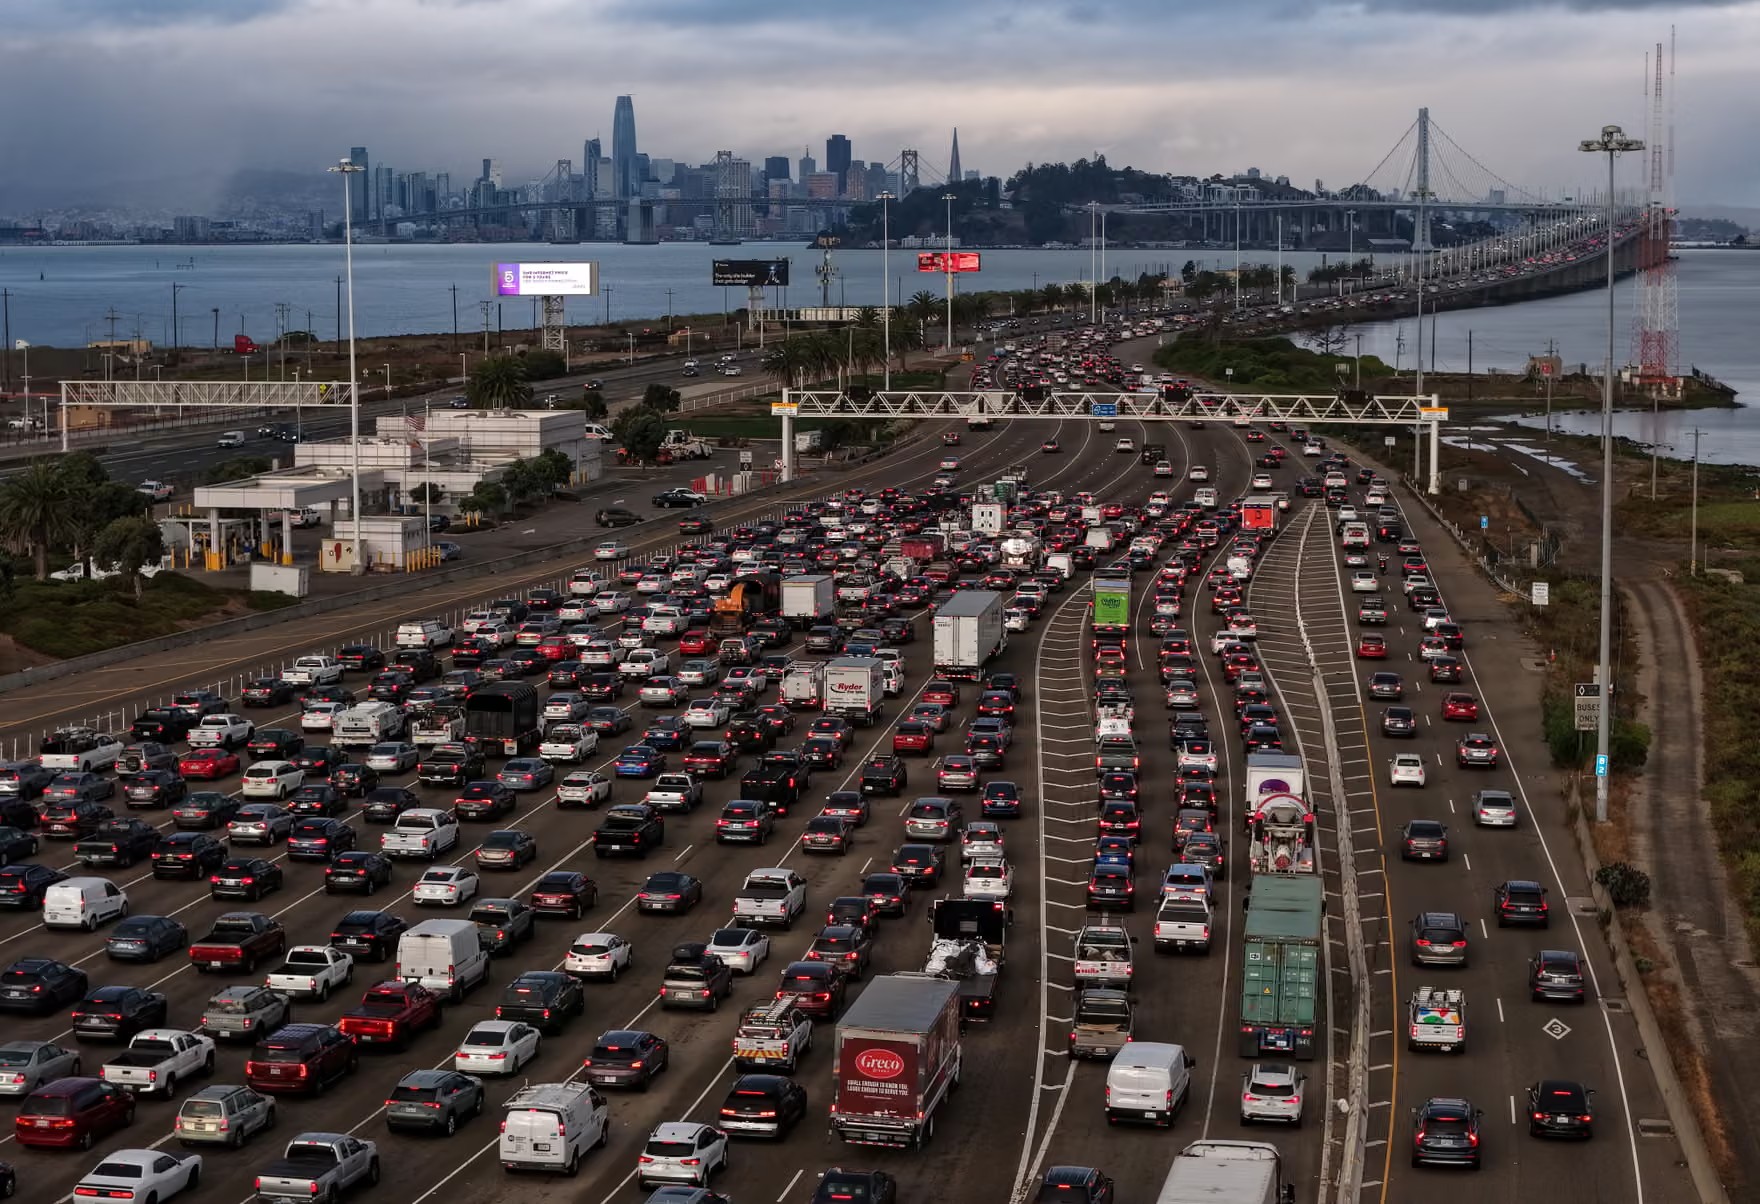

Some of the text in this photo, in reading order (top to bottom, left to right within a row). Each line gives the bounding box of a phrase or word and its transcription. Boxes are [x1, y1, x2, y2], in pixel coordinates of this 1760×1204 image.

[838, 683, 863, 691] Ryder
[1577, 703, 1600, 711] BUSES
[1552, 1024, 1562, 1034] 3
[861, 1055, 900, 1070] Greco
